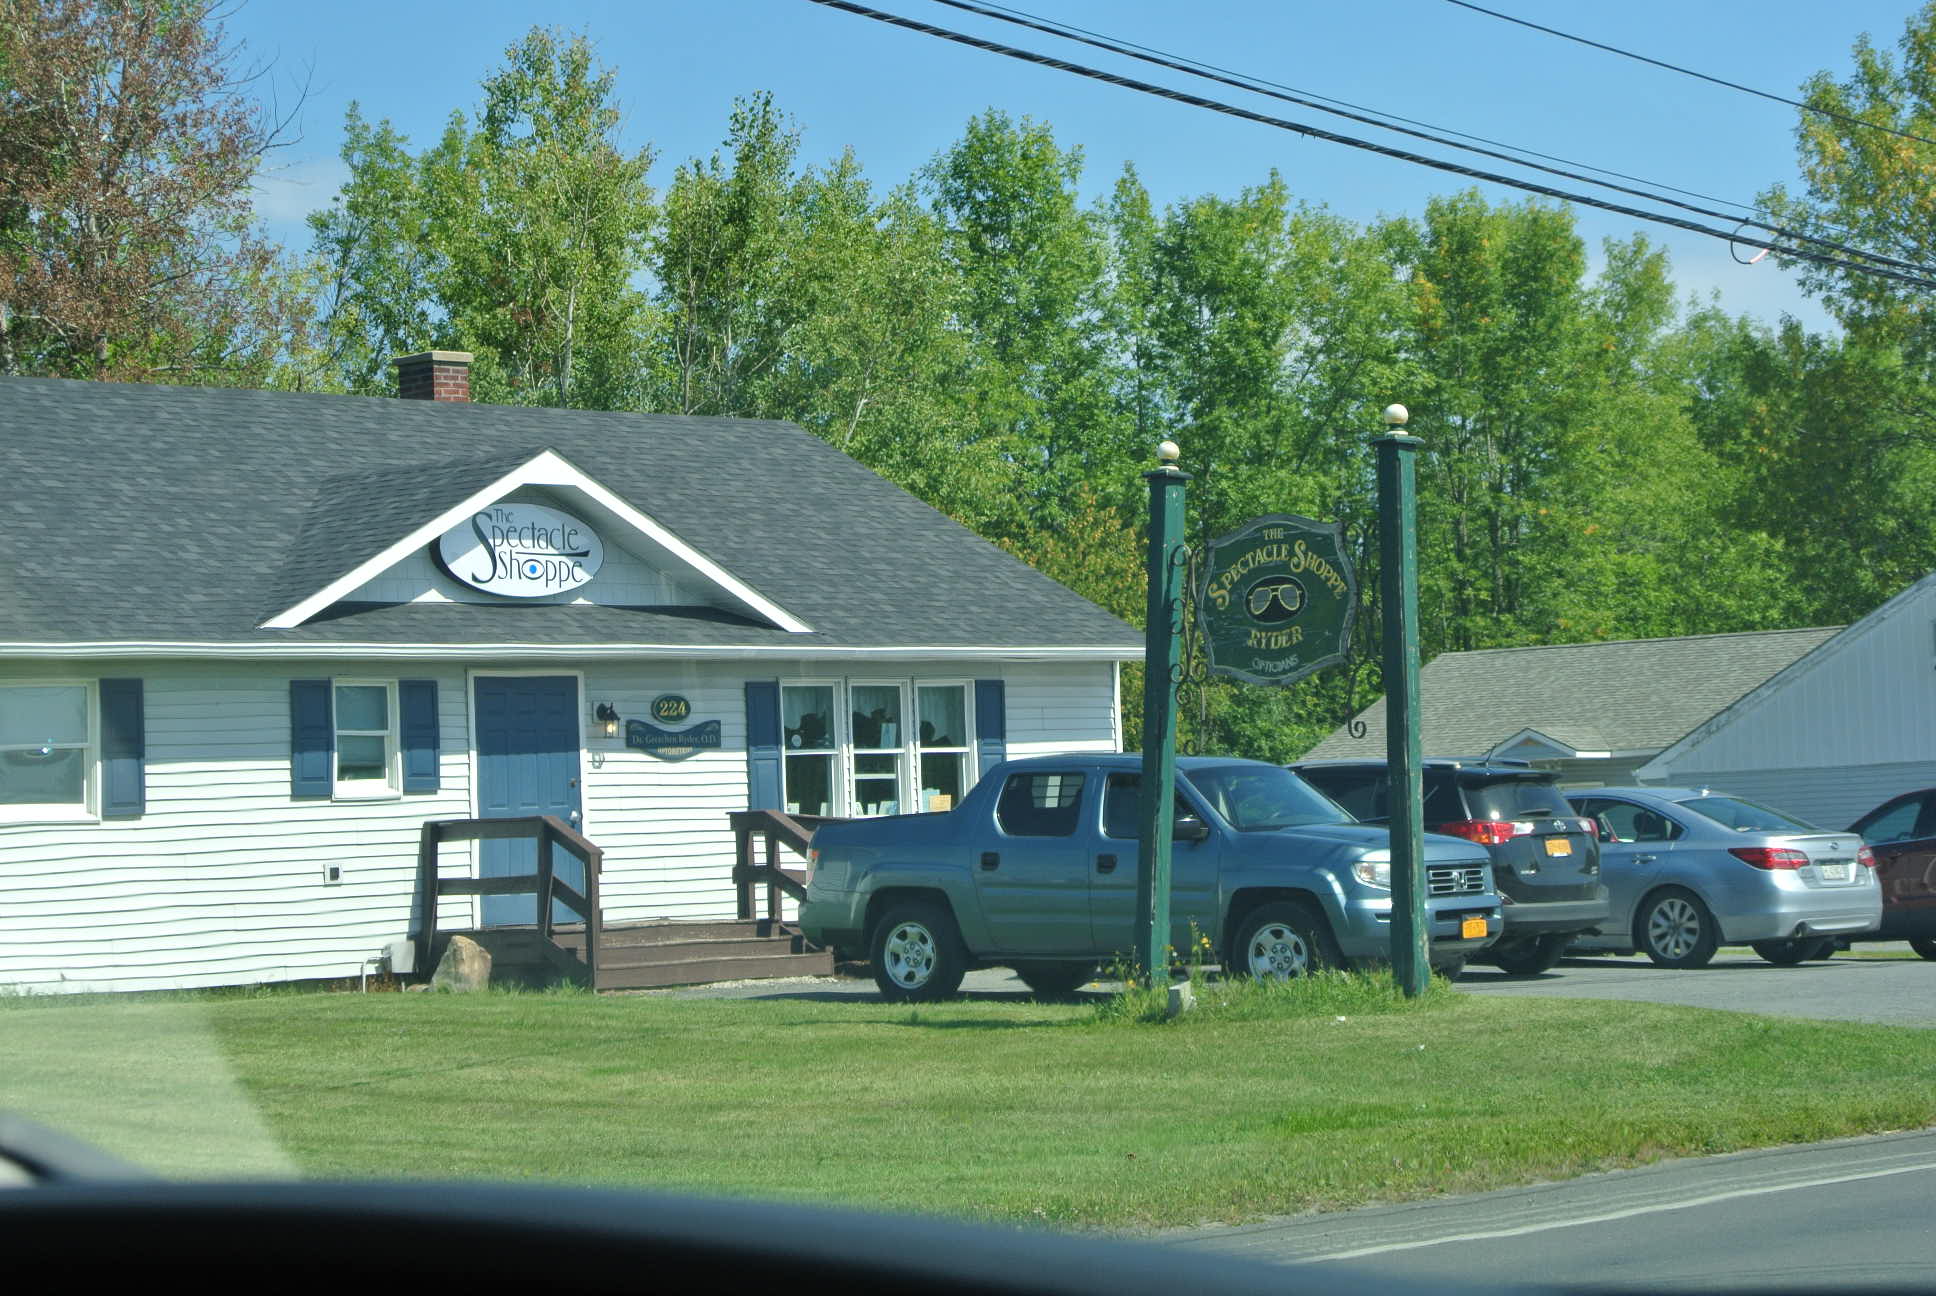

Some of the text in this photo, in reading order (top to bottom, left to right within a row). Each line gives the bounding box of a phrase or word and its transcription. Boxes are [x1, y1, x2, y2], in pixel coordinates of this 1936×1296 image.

[493, 509, 514, 523] The
[1263, 528, 1285, 540] THE
[471, 511, 581, 584] Spectacle
[497, 549, 584, 589] Shoppe
[1208, 539, 1348, 611] SPECTACLE SHOPPE
[1248, 625, 1304, 649] RYDER
[659, 701, 687, 717] 224
